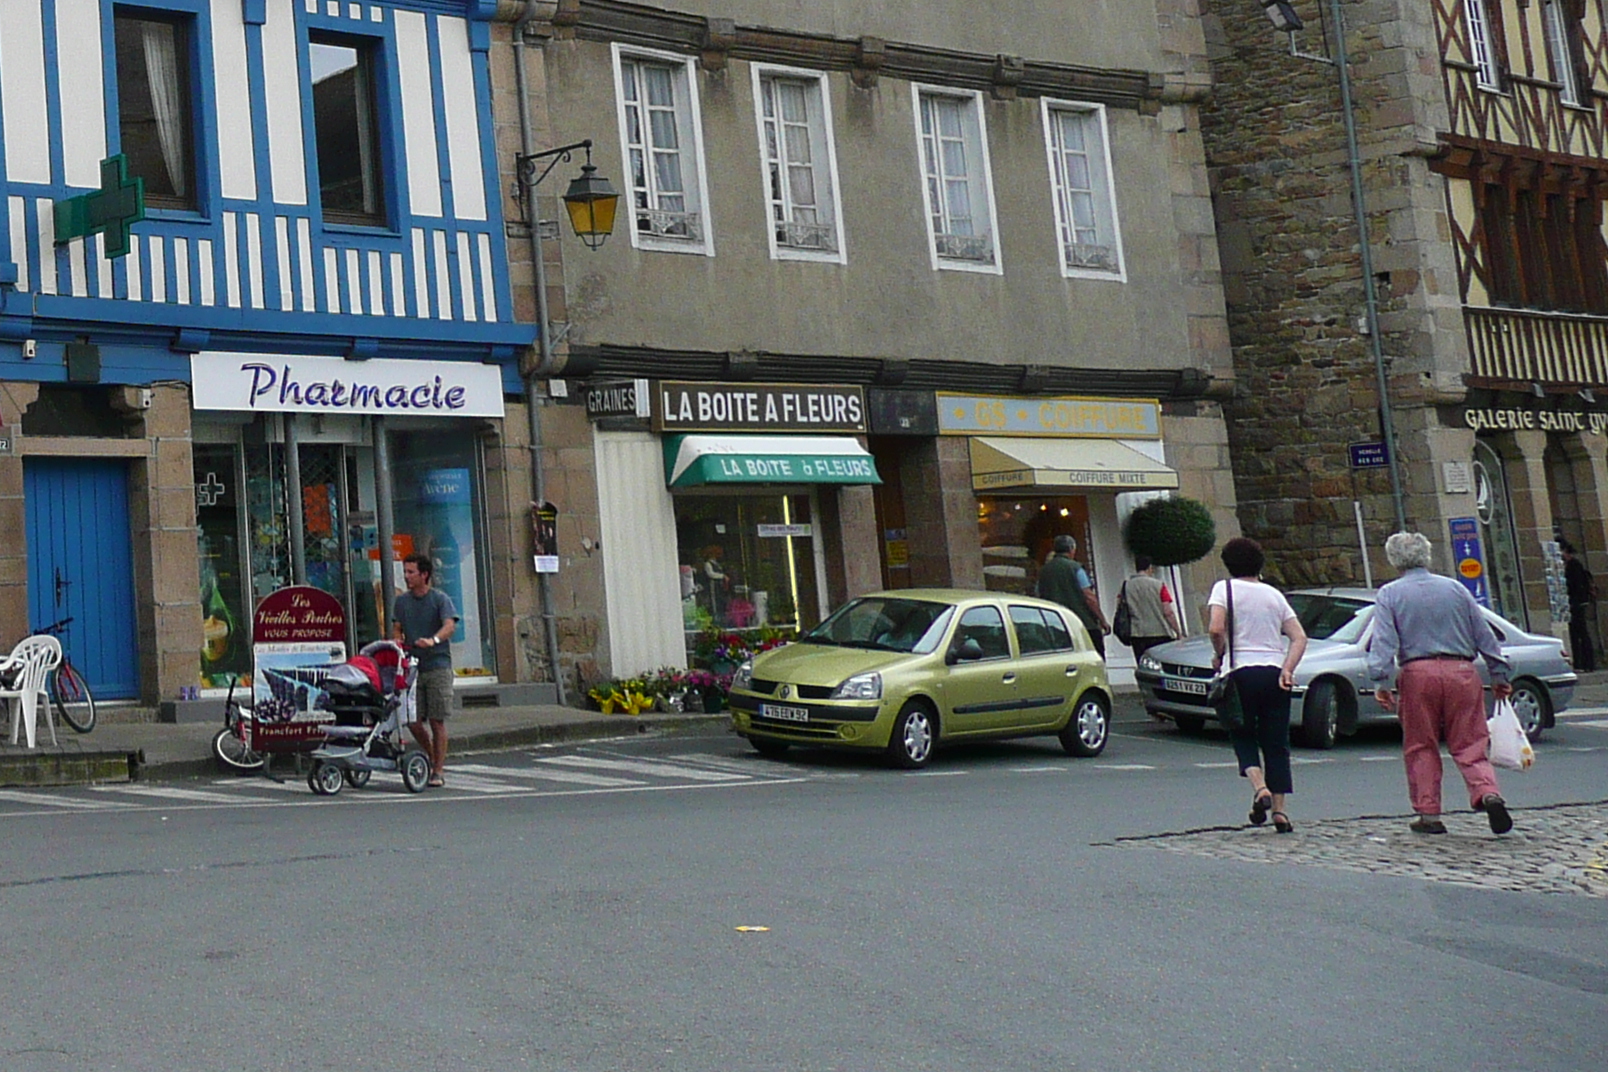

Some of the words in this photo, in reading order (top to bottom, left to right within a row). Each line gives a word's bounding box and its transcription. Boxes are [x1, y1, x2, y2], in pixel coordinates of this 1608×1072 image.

[240, 362, 466, 409] Pharmacie
[587, 388, 636, 412] GRAINES
[663, 391, 693, 421] LA
[698, 392, 759, 422] BOITE
[765, 394, 781, 422] A
[783, 394, 862, 423] FLEURS
[975, 402, 1008, 427] GS
[1037, 403, 1147, 430] COIFFURE
[720, 459, 743, 477] LA
[745, 459, 792, 476] BOITE
[816, 460, 872, 477] FLEURS
[981, 473, 1024, 485] COIFFURE
[1068, 472, 1115, 484] COIFFURE
[1118, 473, 1147, 484] MIXTE
[291, 593, 311, 608] Les
[301, 609, 343, 624] Poutres
[264, 629, 289, 638] VOUS
[292, 629, 333, 638] PROPOSE
